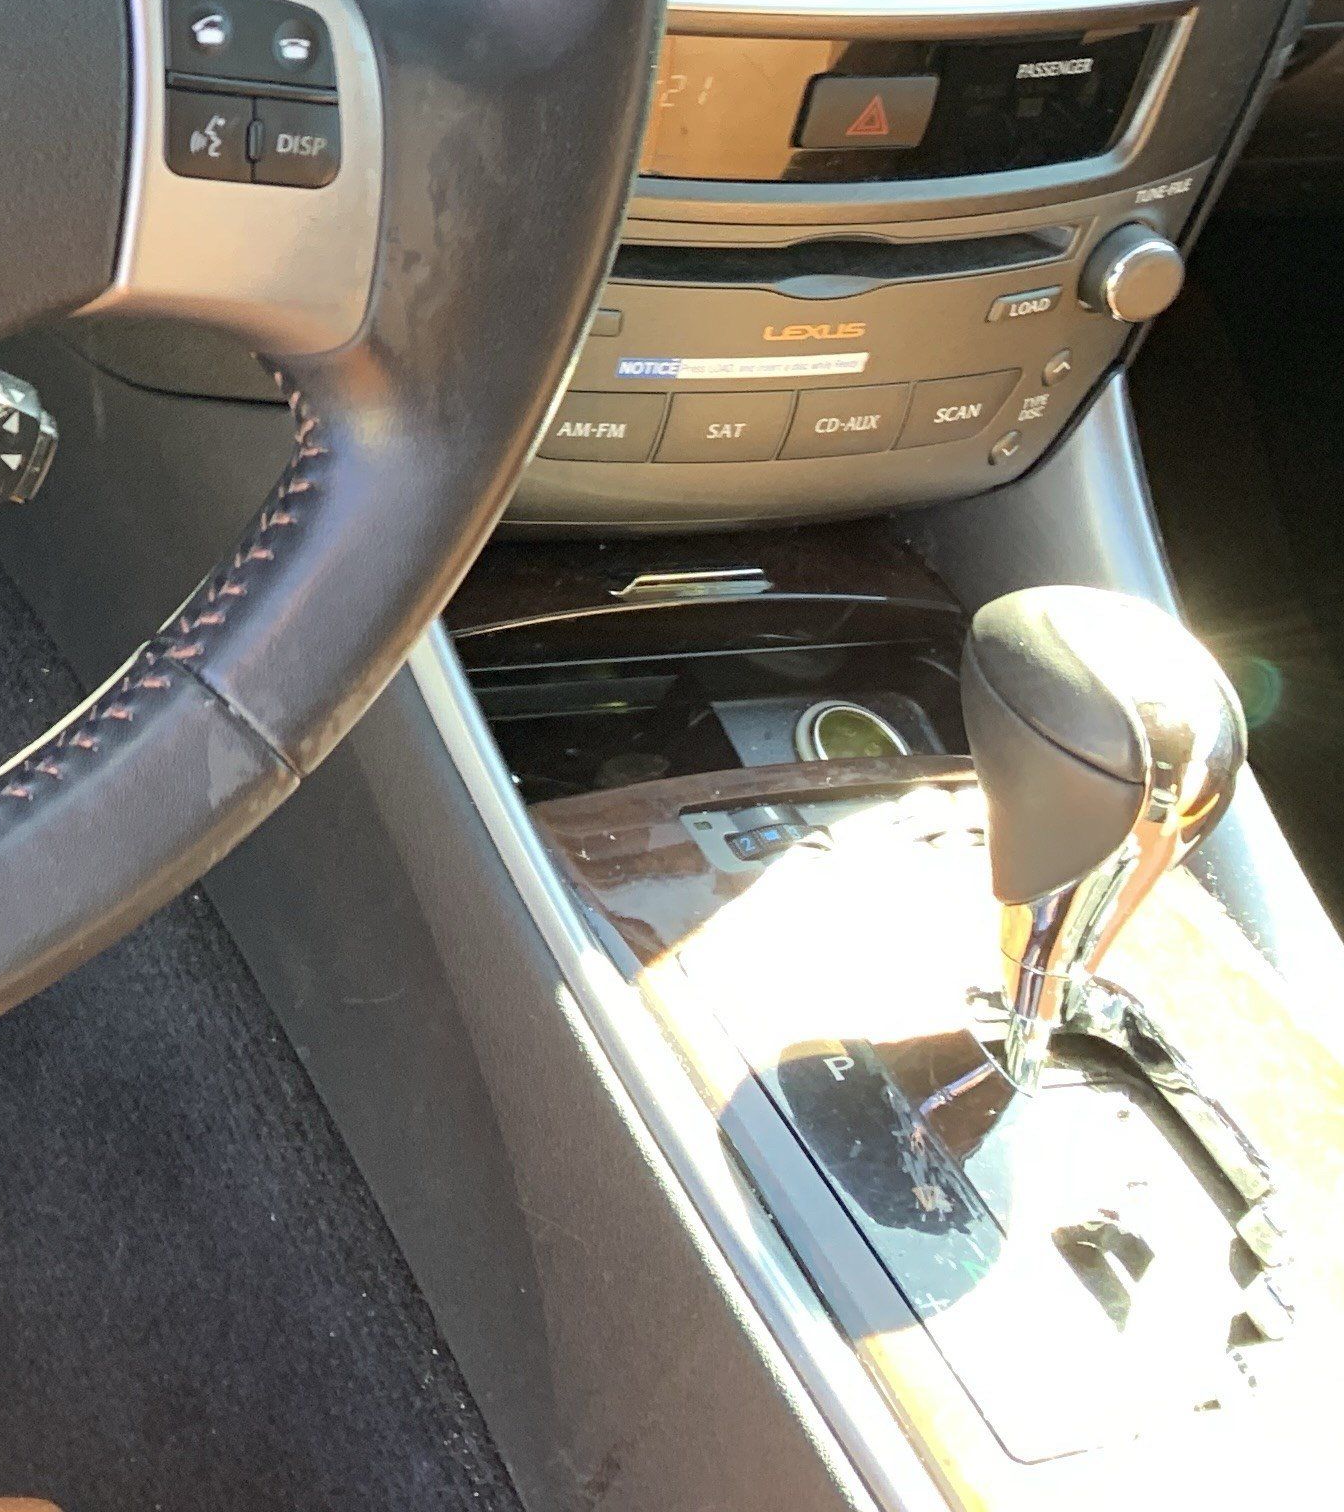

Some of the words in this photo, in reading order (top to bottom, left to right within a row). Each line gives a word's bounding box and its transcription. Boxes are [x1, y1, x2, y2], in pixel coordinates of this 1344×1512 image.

[1016, 57, 1094, 79] PASSENGER
[276, 133, 328, 158] DISP
[1009, 297, 1051, 317] LOAD
[763, 322, 866, 341] LEXUS
[618, 360, 679, 376] NOTICE
[934, 402, 983, 423] SCAN
[557, 421, 627, 438] AM-FM
[706, 422, 747, 439] SAT
[814, 414, 881, 434] CD-AUX
[823, 1055, 855, 1082] P
